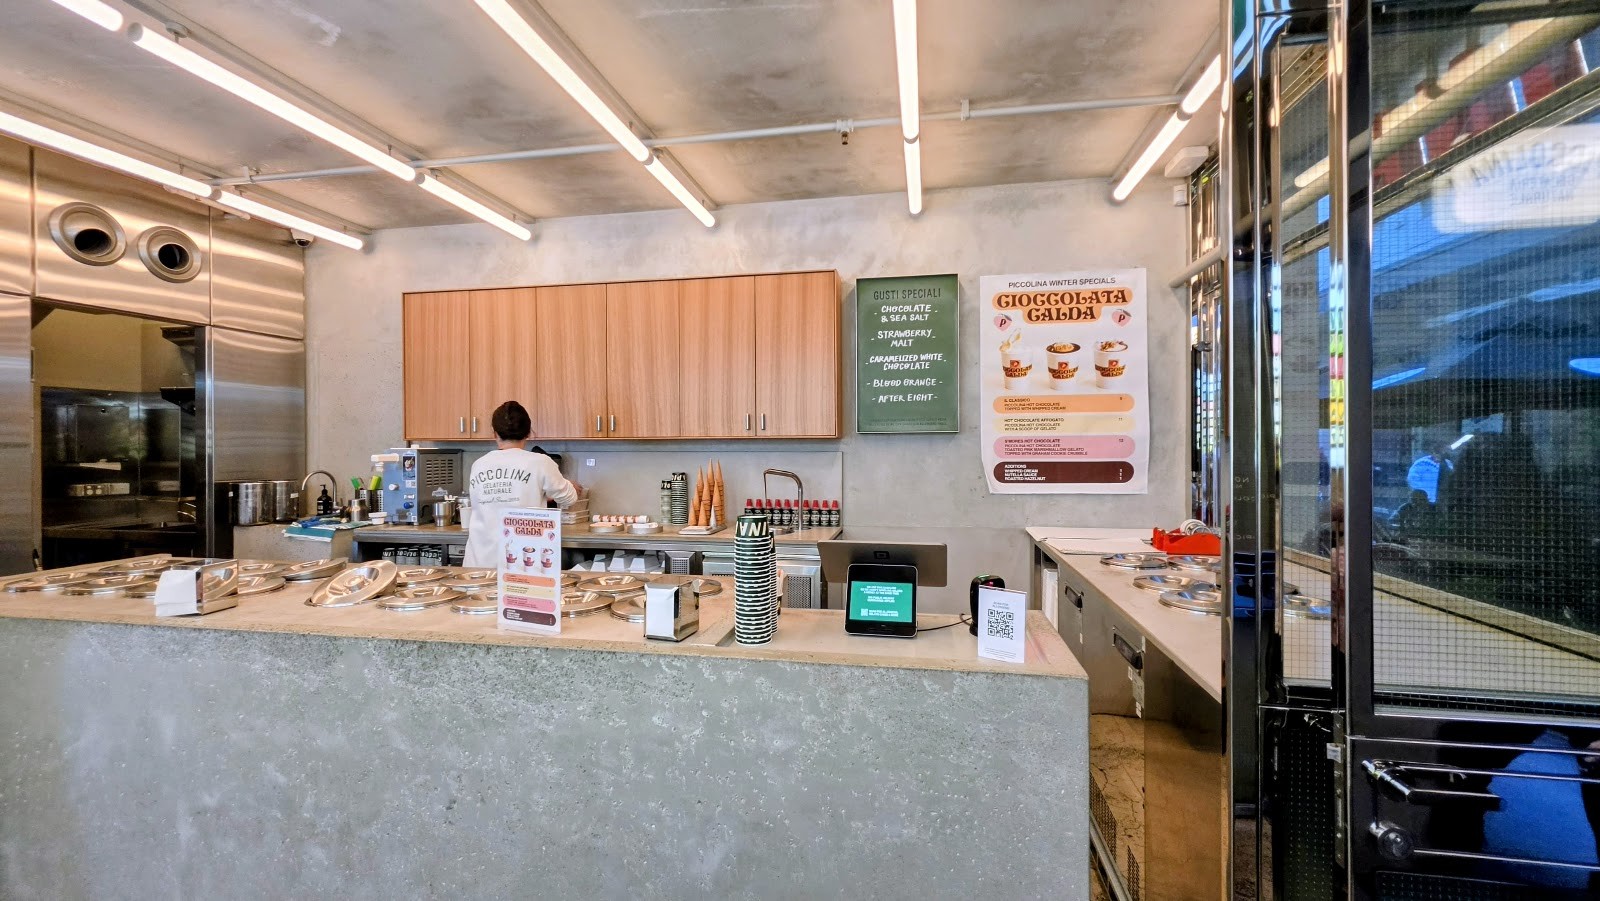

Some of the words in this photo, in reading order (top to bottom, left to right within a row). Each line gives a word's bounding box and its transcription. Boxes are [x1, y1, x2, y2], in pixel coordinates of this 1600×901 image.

[1008, 281, 1048, 289] PICCOLINA
[1049, 279, 1078, 287] WINTER
[1079, 277, 1116, 286] SPECIALS
[873, 290, 899, 301] GUSTI
[902, 288, 941, 299] SPECIALI
[996, 289, 1128, 308] CIOCCOLATA
[881, 304, 931, 313] CHOCOLATE
[881, 315, 888, 323] &
[890, 314, 907, 322] SEA
[1027, 306, 1096, 322] CALDA
[877, 329, 933, 339] STRAWBERRY
[891, 339, 914, 347] MALT
[869, 355, 918, 363] CARAMELIZED
[920, 353, 943, 361] WHITE
[883, 362, 930, 370] CHOCOLATE
[873, 379, 901, 388] BLOOD
[903, 378, 937, 387] ORANGE
[878, 394, 905, 403] AFTER
[908, 393, 934, 402] EIGHT
[470, 468, 531, 489] PICCOLINA
[504, 518, 554, 529] CIOCCOLATA
[515, 526, 542, 536] CALDA
